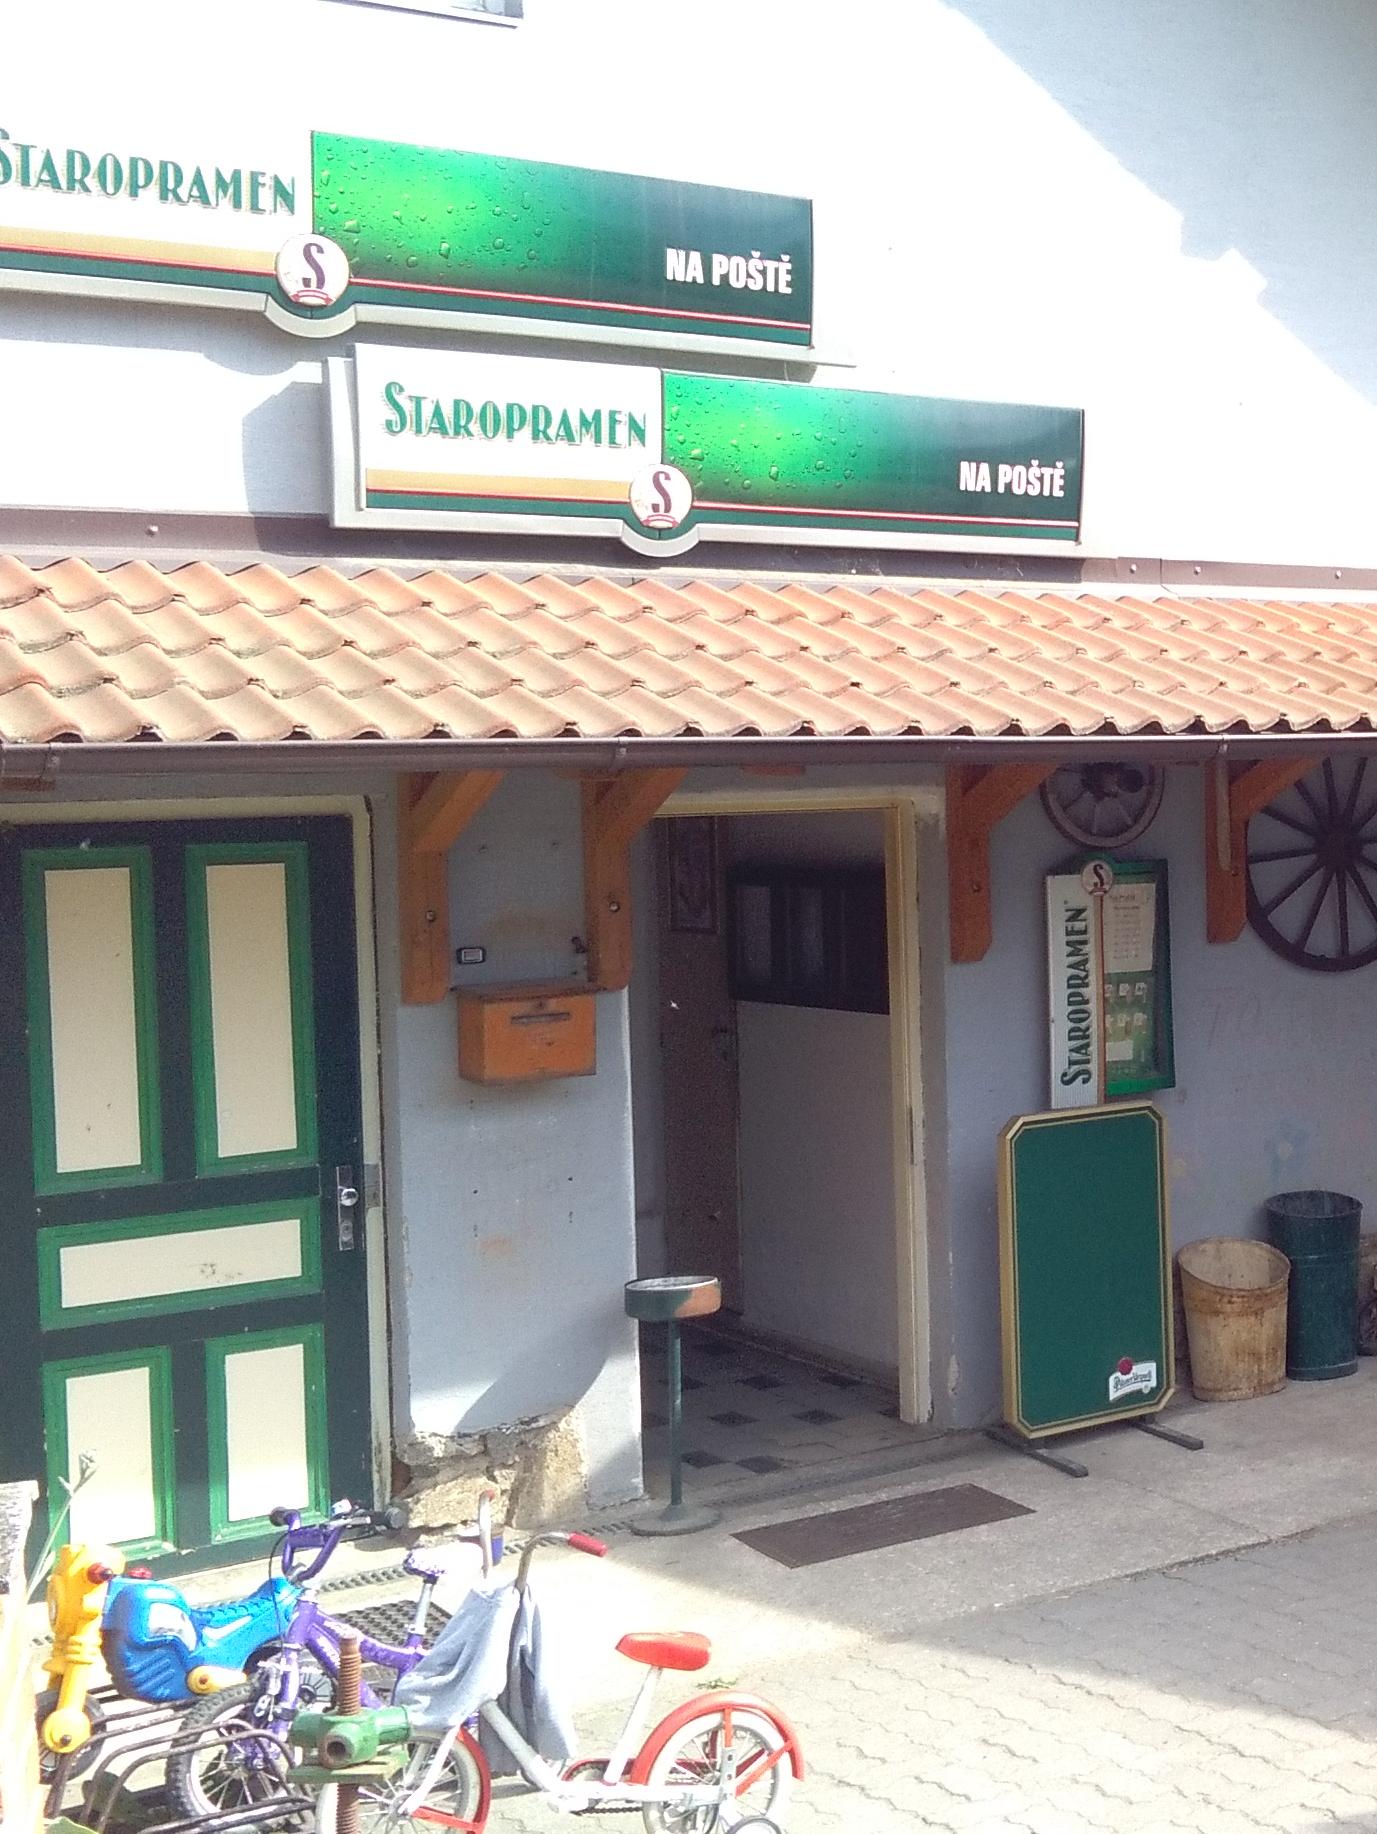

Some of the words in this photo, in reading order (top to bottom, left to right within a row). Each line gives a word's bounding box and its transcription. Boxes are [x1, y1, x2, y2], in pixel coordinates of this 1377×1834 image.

[302, 242, 326, 290] S
[666, 247, 705, 285] NA
[712, 250, 793, 295] POŠTĚ
[384, 381, 647, 449] STAROPRAMEN
[651, 471, 672, 514] S
[959, 461, 992, 493] NA
[997, 459, 1065, 498] POŠTĚ
[1060, 907, 1092, 1087] STAROPRAMEN
